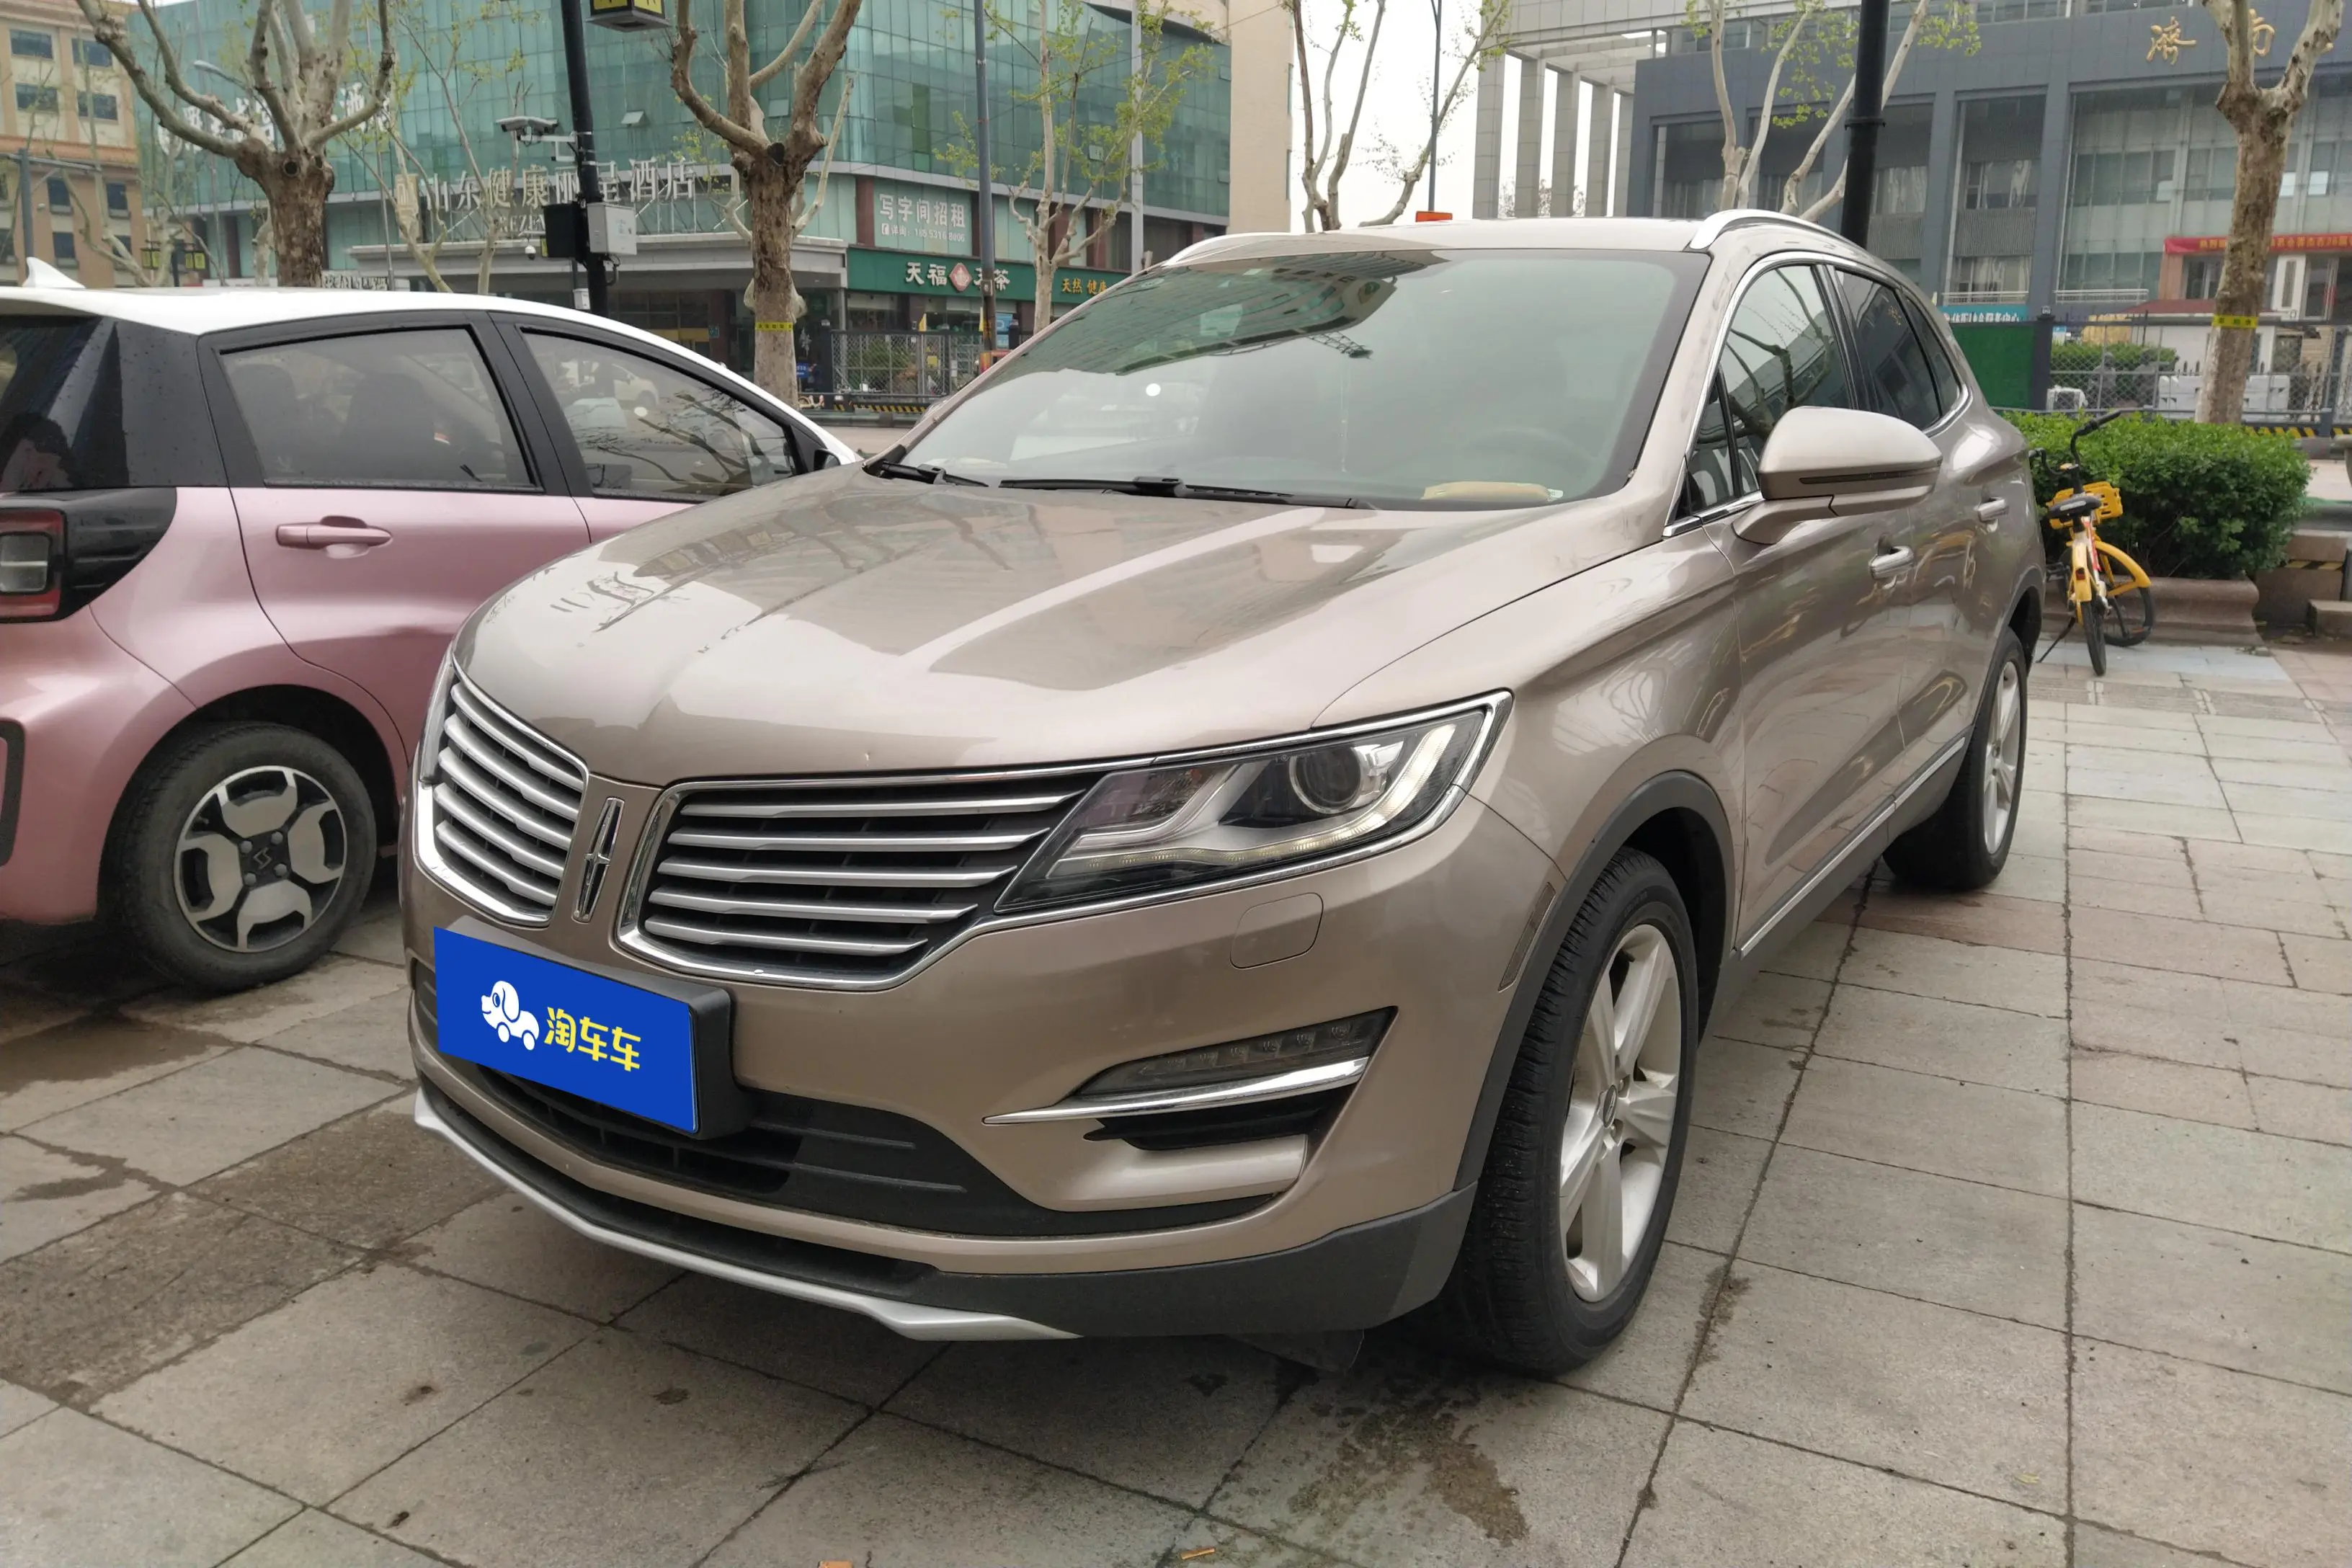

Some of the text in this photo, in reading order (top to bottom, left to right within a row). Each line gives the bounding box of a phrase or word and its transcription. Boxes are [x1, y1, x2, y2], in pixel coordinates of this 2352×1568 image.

[880, 194, 965, 228] 写字间招租
